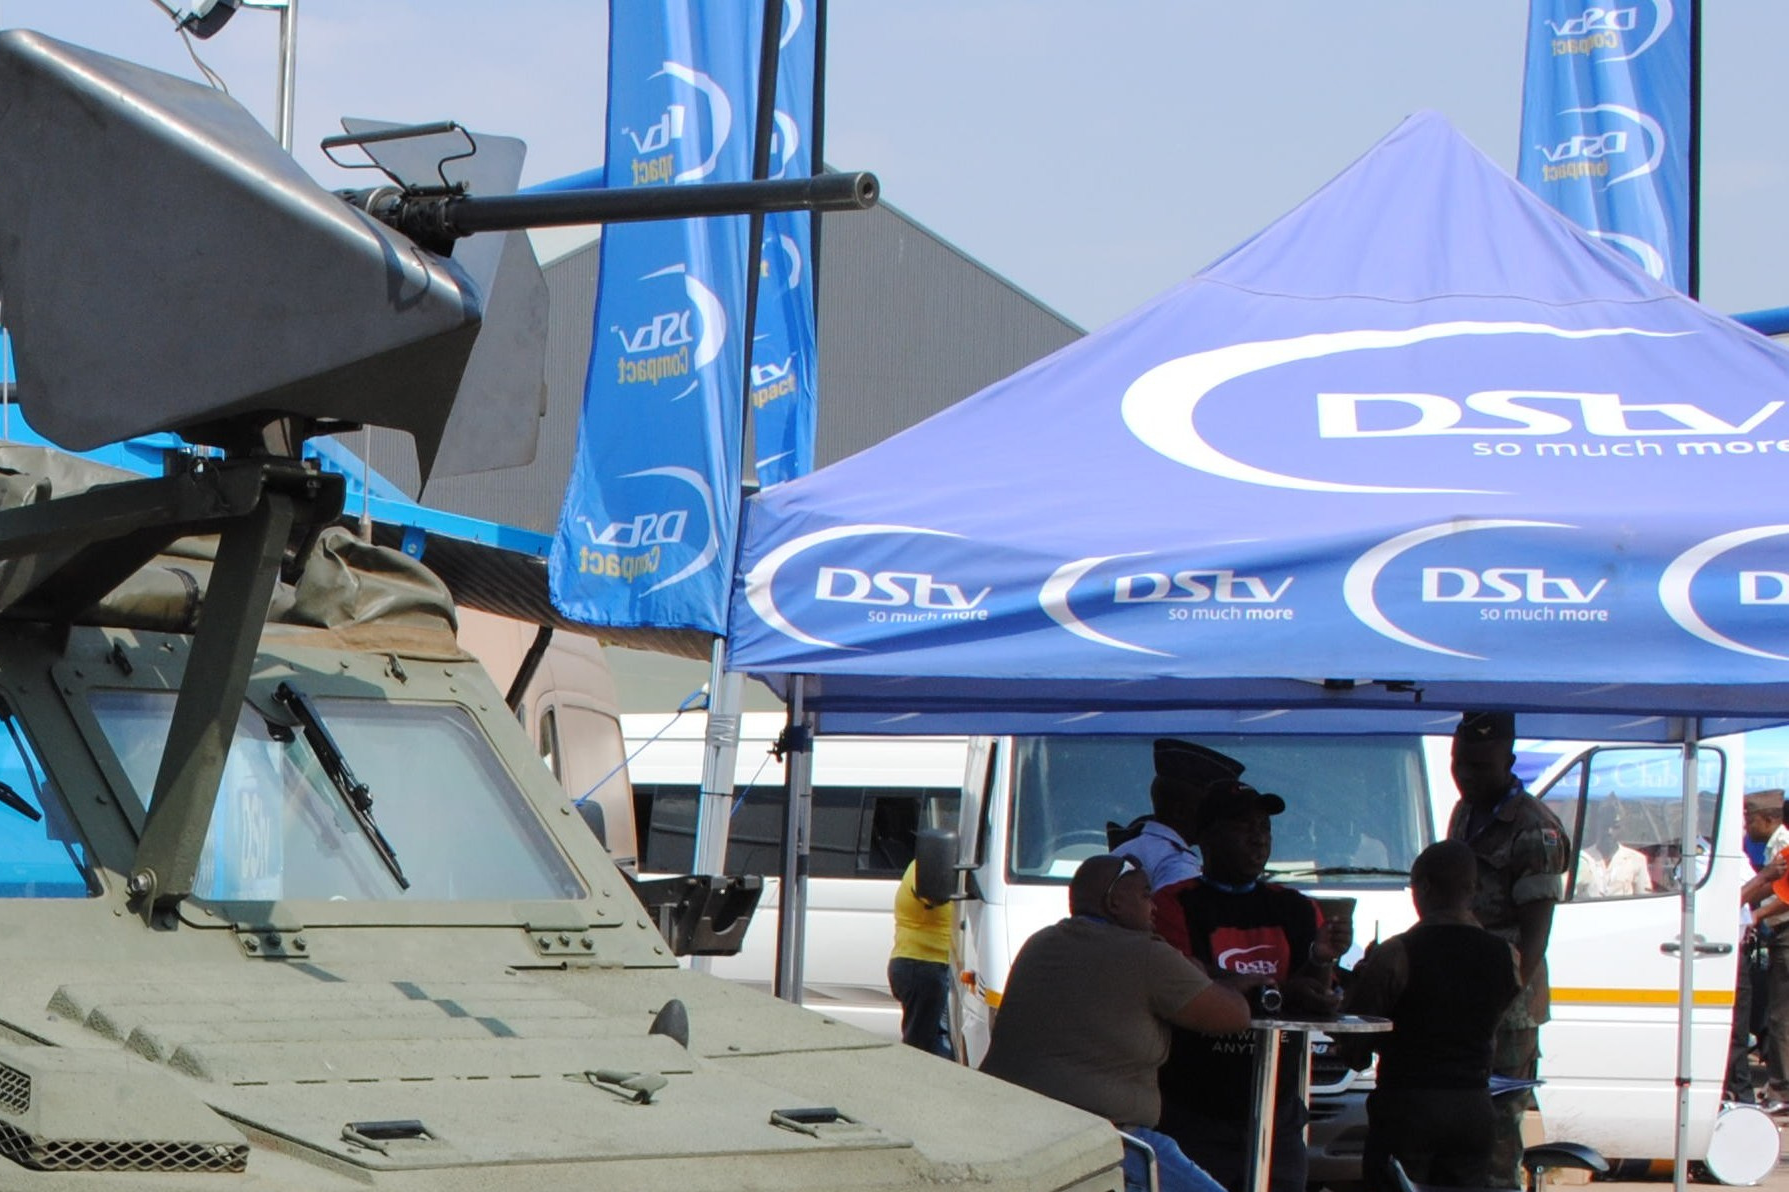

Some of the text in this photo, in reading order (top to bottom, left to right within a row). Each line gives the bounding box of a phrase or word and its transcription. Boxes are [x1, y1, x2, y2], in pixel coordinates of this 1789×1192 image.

[1317, 391, 1785, 438] DStv
[1473, 442, 1522, 456] so
[1536, 439, 1662, 457] much
[815, 566, 991, 610] DStv
[1114, 570, 1294, 603] DStv
[1422, 567, 1607, 603] DStv
[867, 609, 988, 623] so much more
[1168, 605, 1293, 621] so much more
[1480, 605, 1608, 621] so much more
